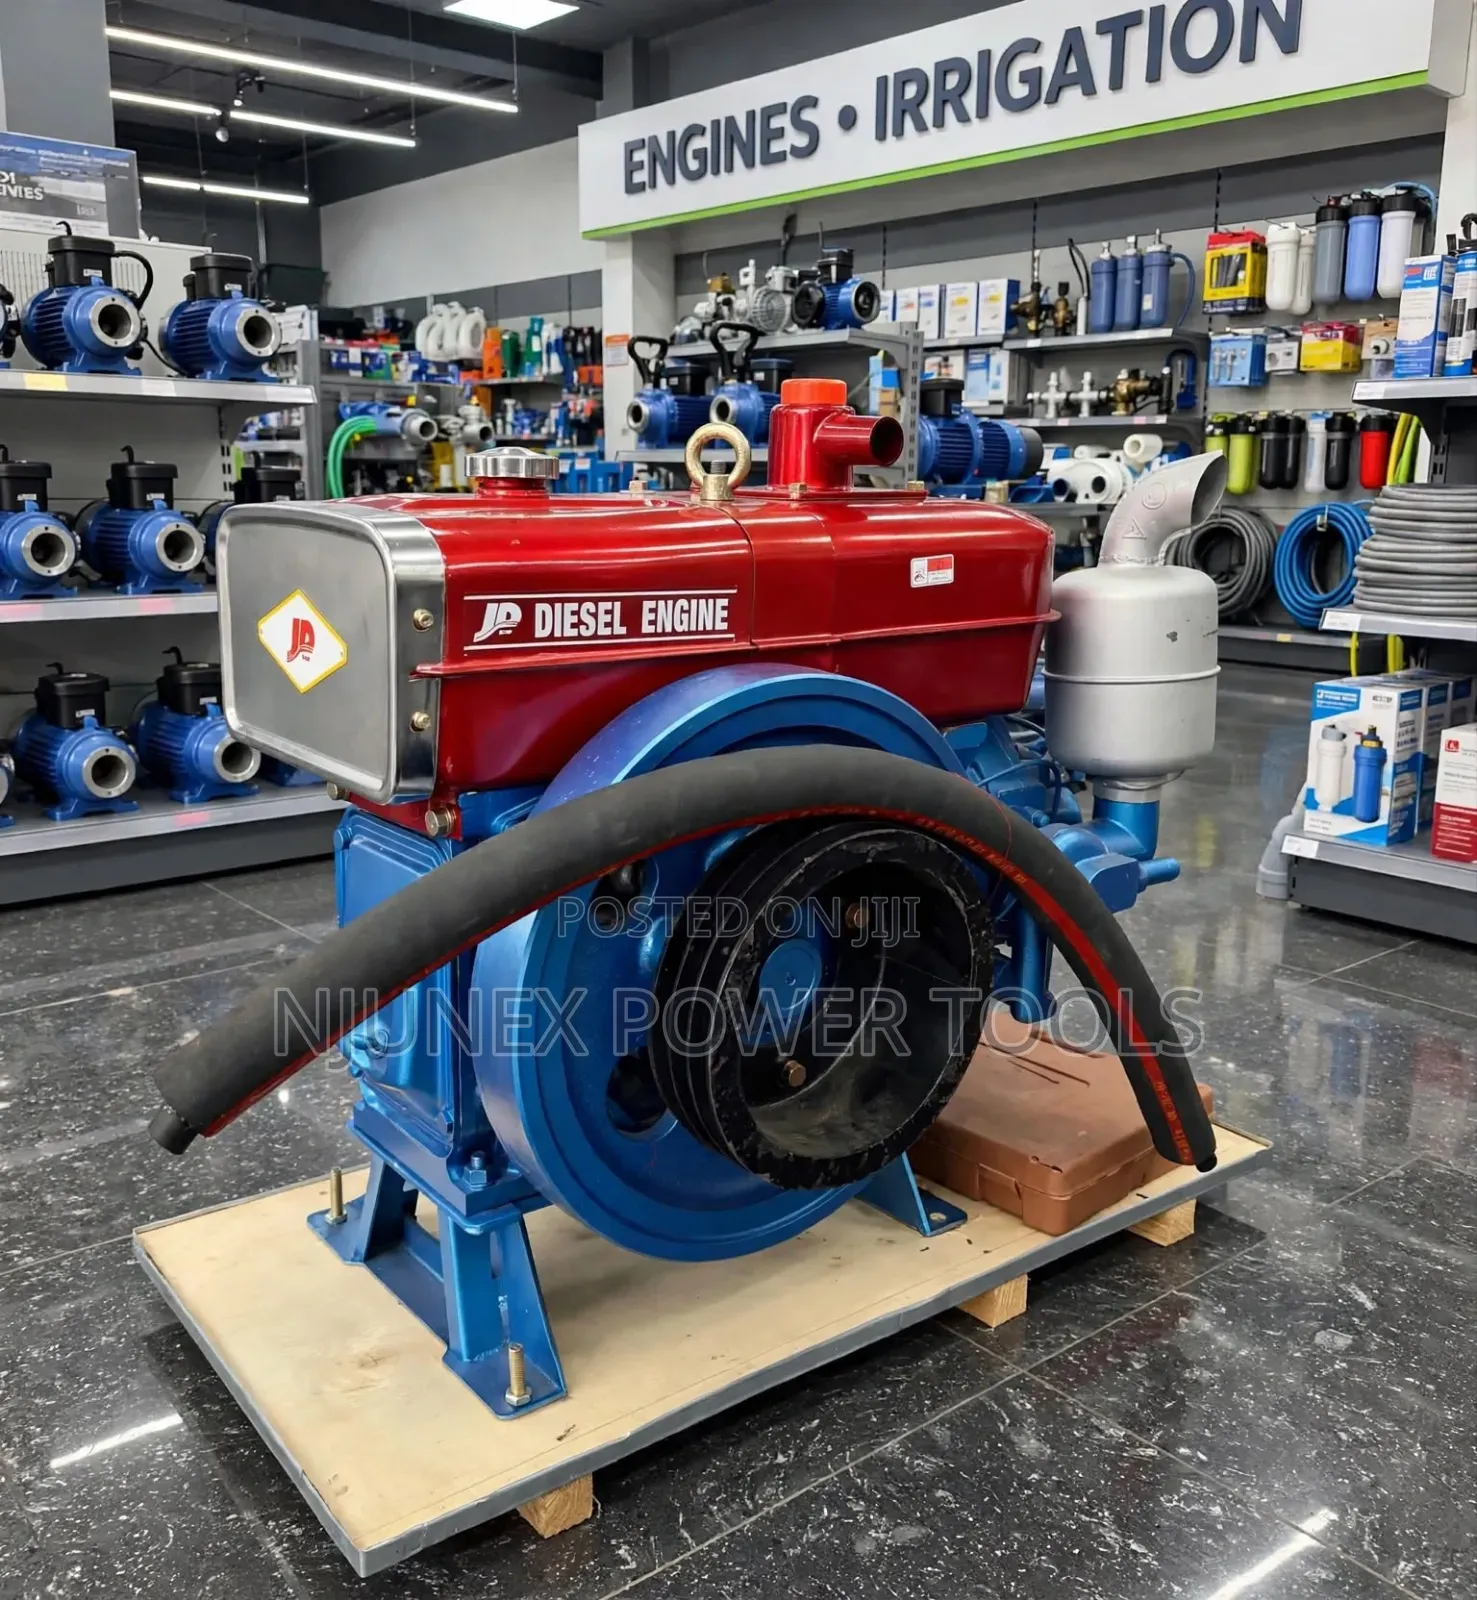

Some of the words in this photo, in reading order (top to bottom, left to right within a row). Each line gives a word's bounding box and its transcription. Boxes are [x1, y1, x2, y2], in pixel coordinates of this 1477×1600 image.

[624, 95, 820, 195] ENGINES
[875, 0, 1301, 142] IRRIGATION
[534, 601, 627, 638] DIESEL
[641, 598, 729, 634] ENGINE
